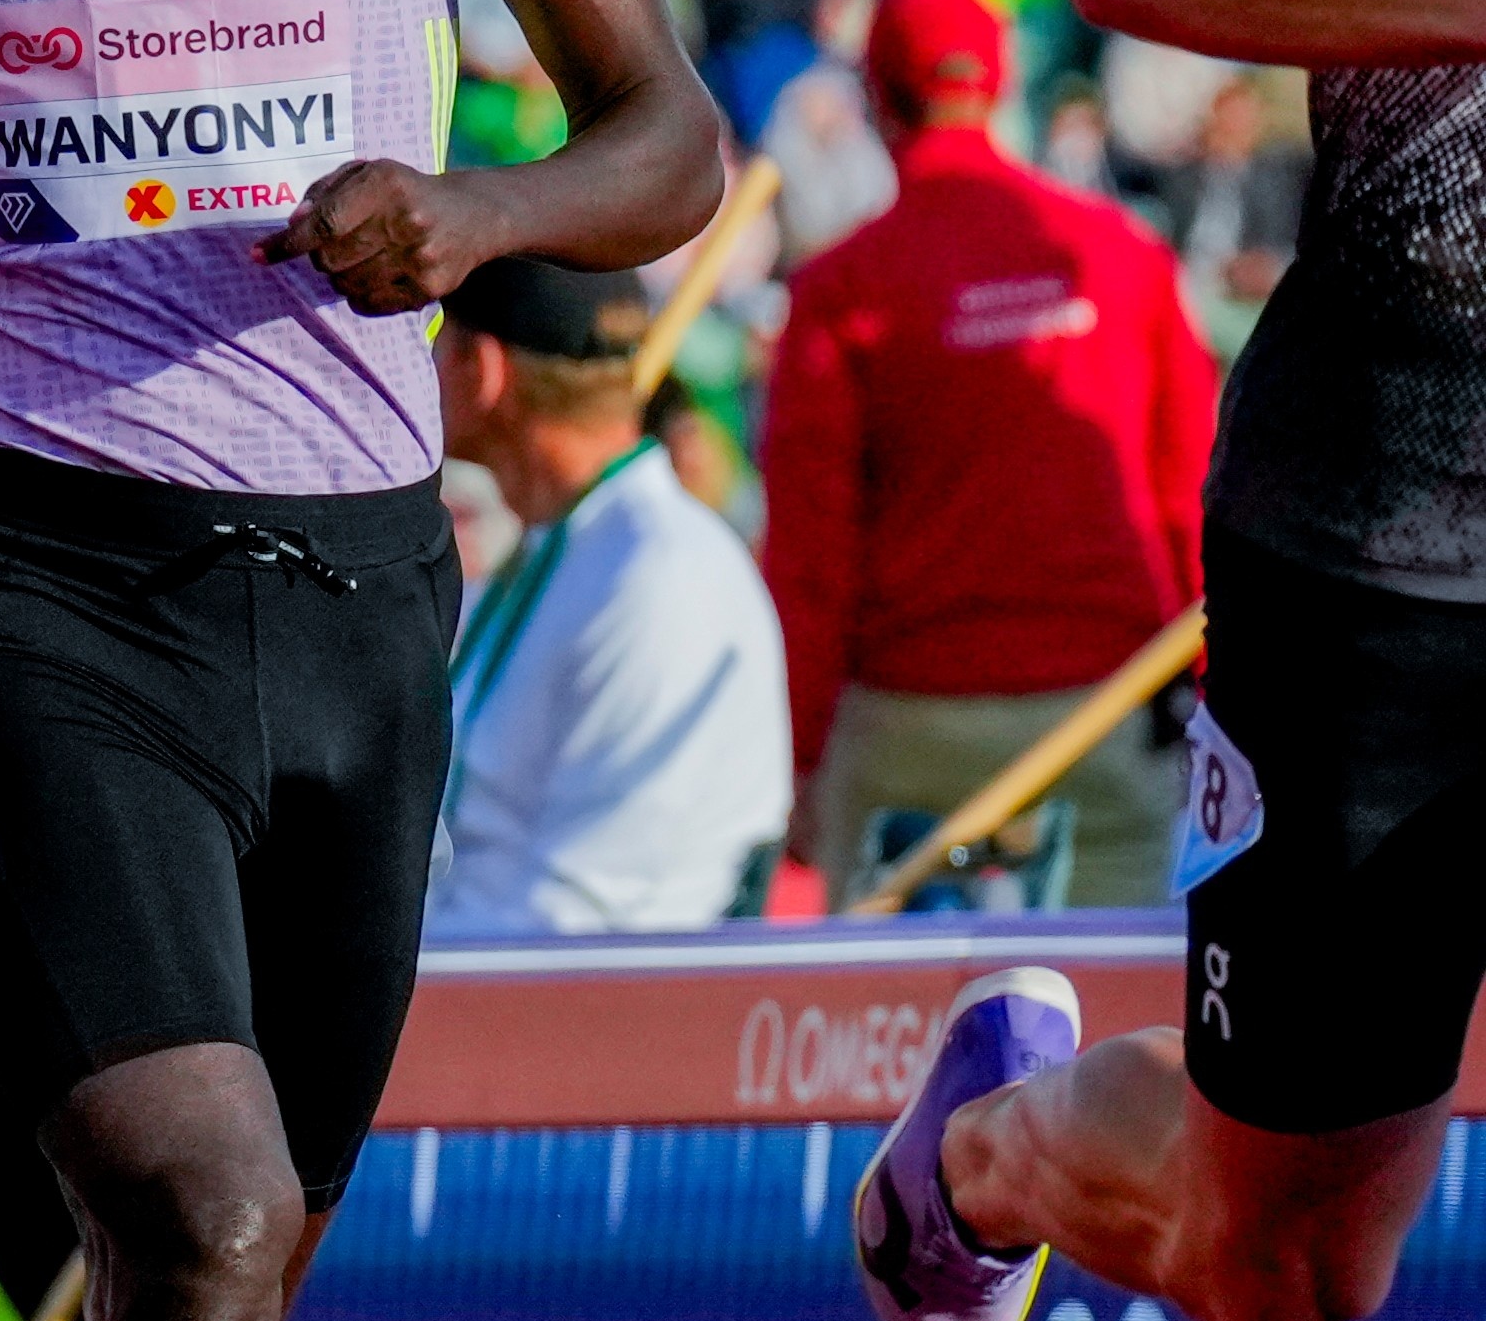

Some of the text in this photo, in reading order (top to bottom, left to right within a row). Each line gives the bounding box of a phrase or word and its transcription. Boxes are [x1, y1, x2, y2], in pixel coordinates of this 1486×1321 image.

[98, 10, 327, 62] Storebrand
[188, 181, 298, 212] EXTRA
[1201, 752, 1227, 845] 8
